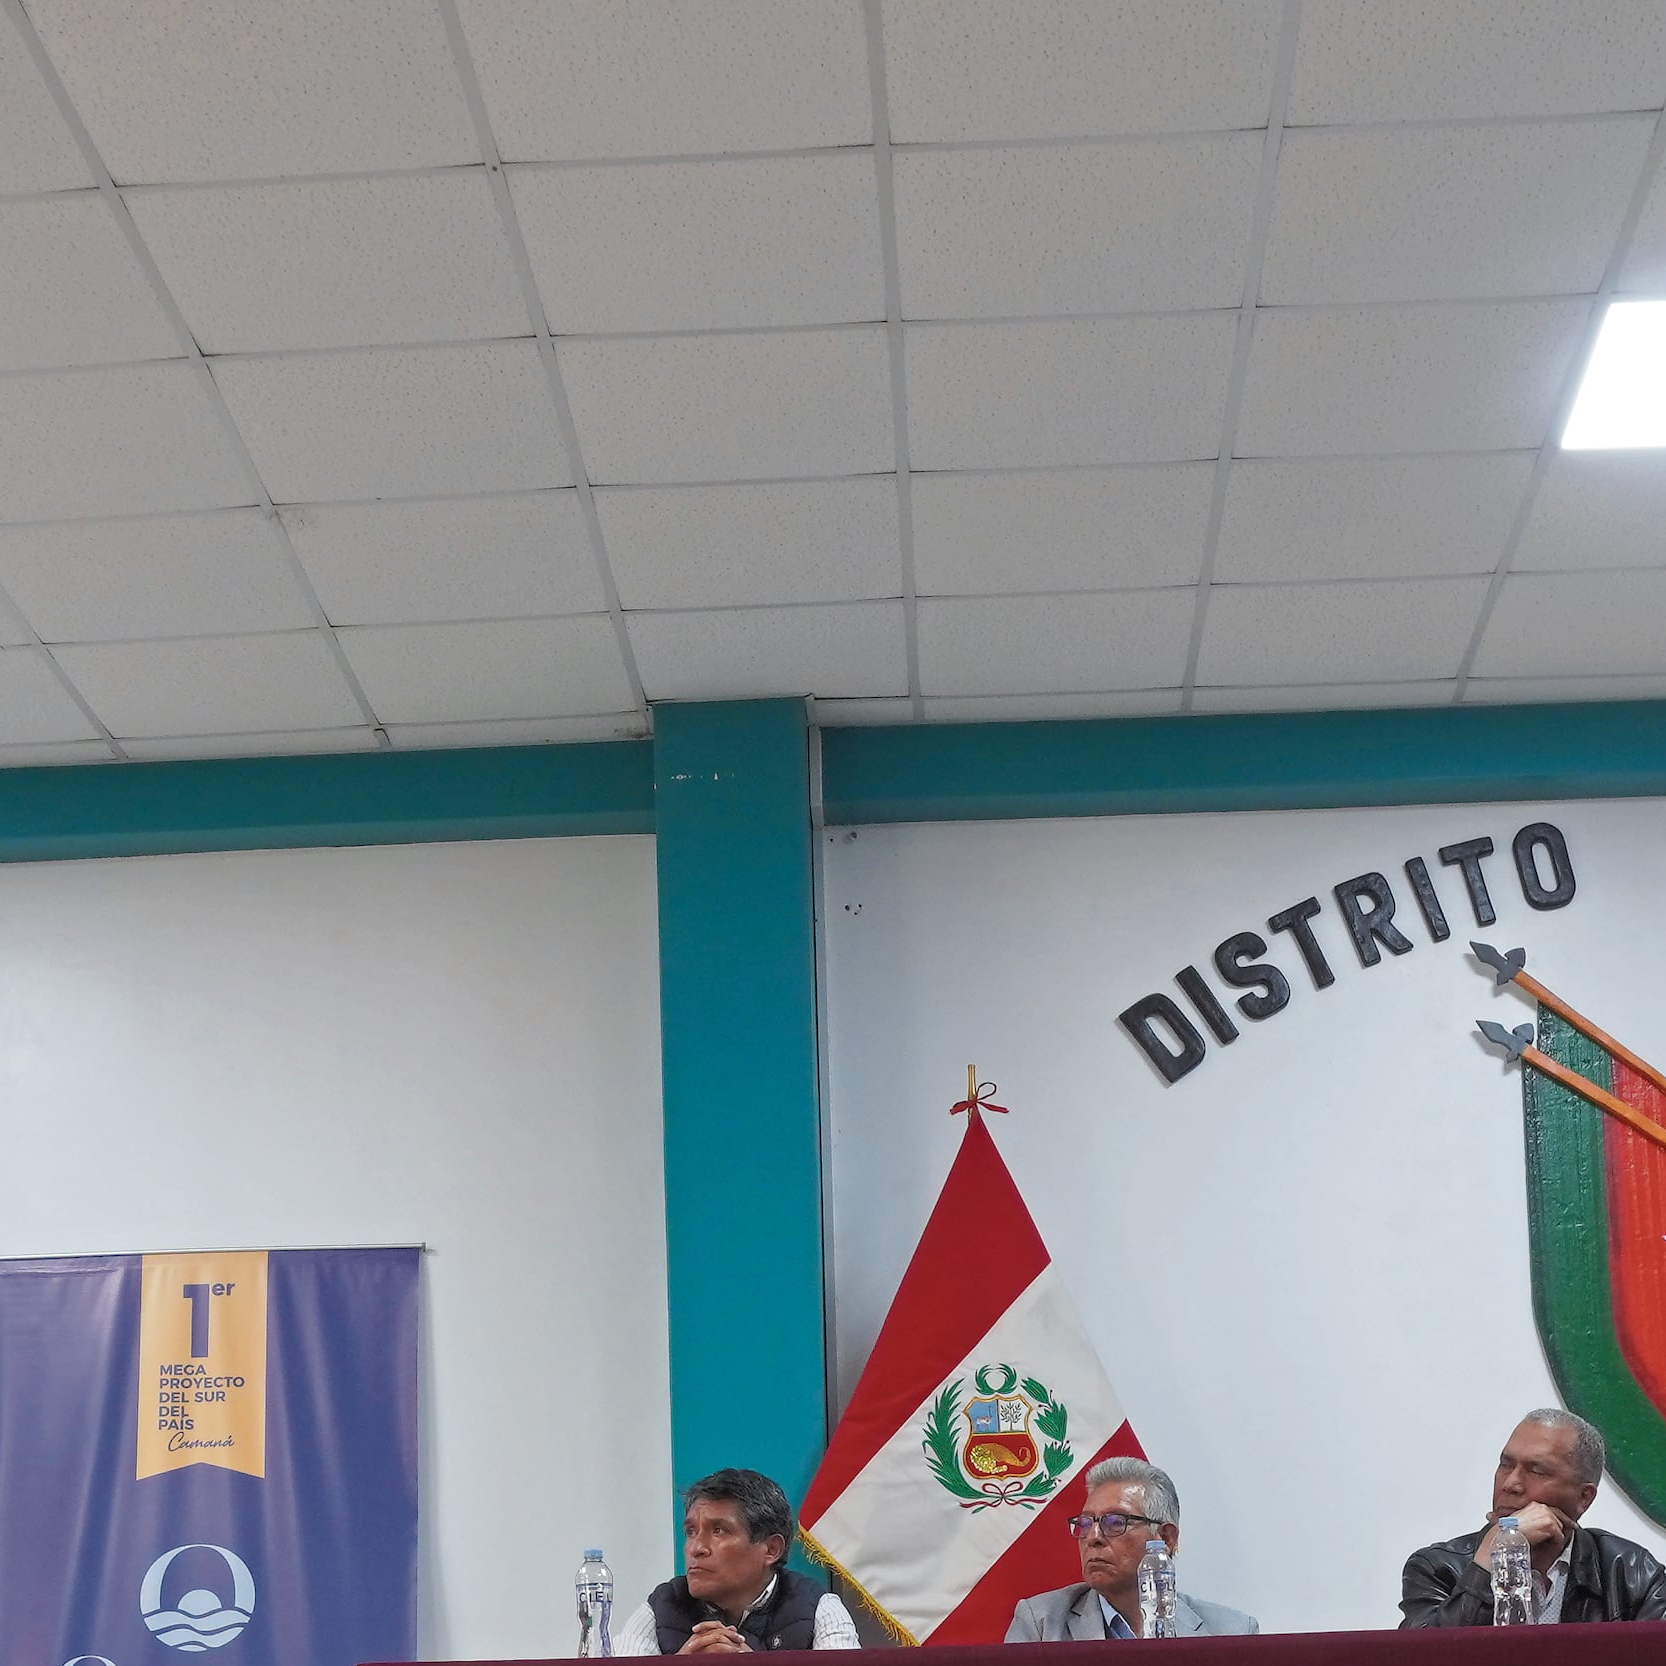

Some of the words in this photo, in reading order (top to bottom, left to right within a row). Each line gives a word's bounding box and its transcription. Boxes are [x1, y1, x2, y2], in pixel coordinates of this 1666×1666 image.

[1117, 821, 1579, 1086] DISTRITO
[159, 1364, 207, 1376] MEGA
[159, 1376, 245, 1389] PROYECTO
[159, 1392, 190, 1404] DEL
[194, 1391, 226, 1403] SUR
[158, 1405, 190, 1417] DEL
[167, 1431, 235, 1452] Camaná
